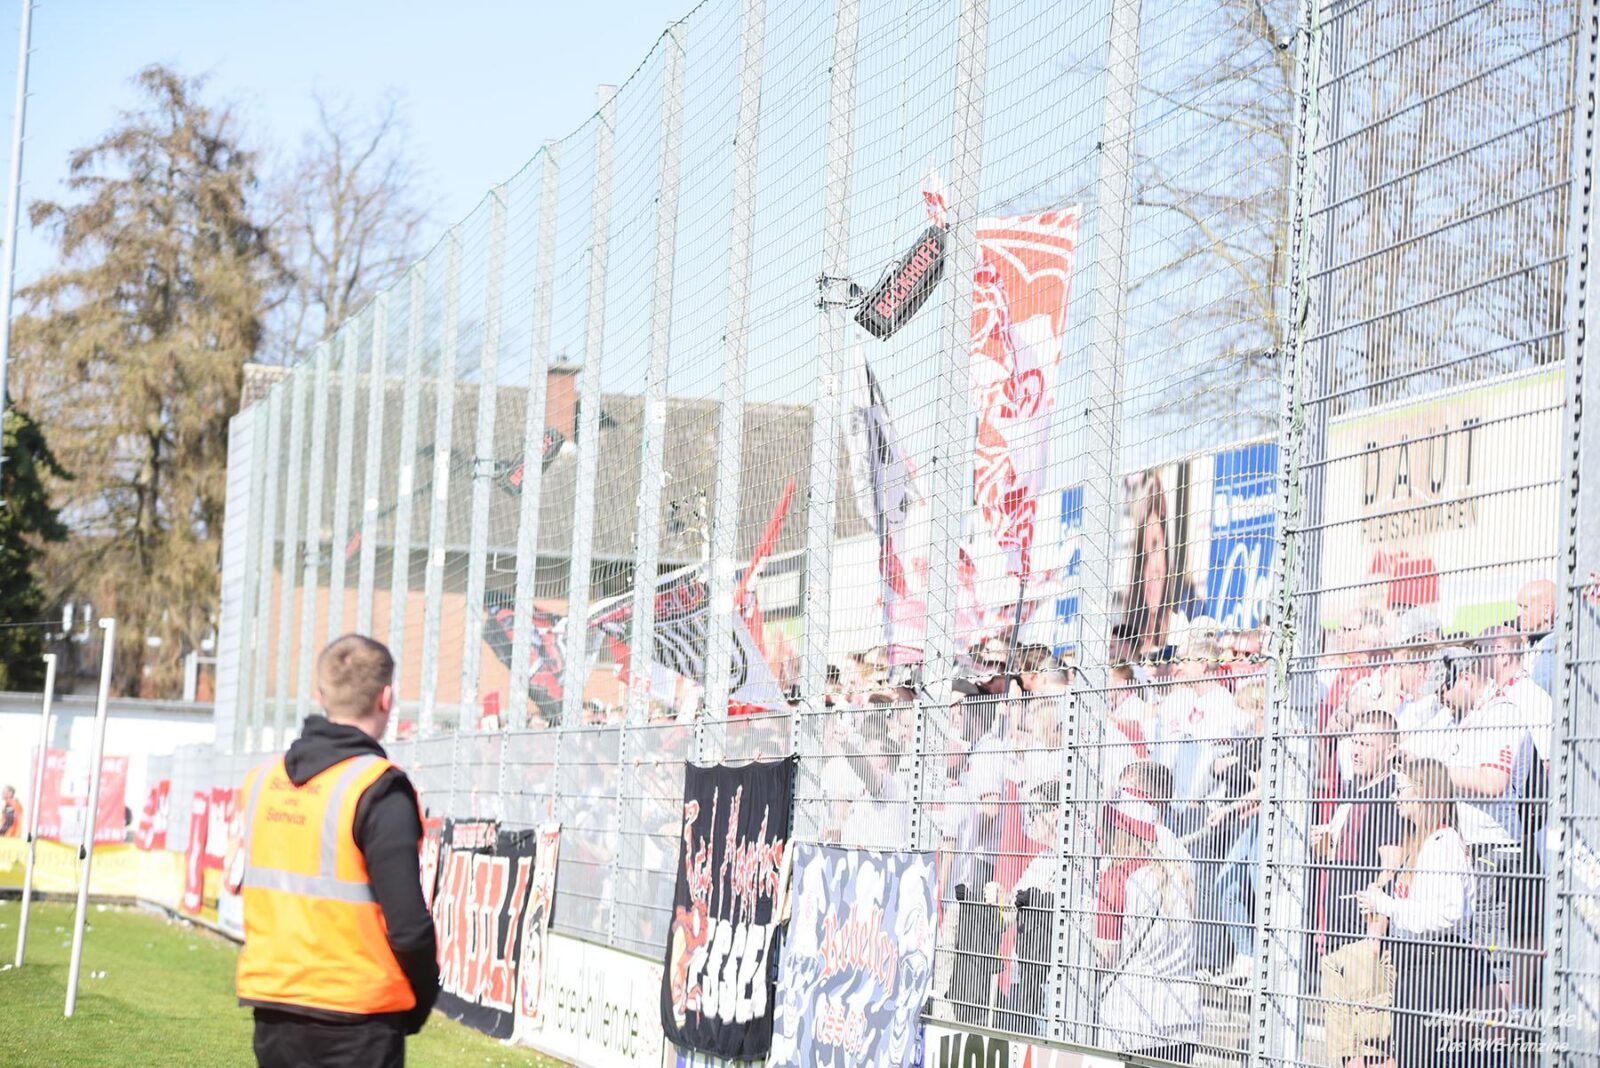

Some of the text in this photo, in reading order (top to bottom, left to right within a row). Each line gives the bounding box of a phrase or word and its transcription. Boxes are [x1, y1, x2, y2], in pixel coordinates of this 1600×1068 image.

[876, 237, 940, 319] BECKHOFF
[1363, 418, 1479, 505] DAUT
[266, 806, 306, 825] Service
